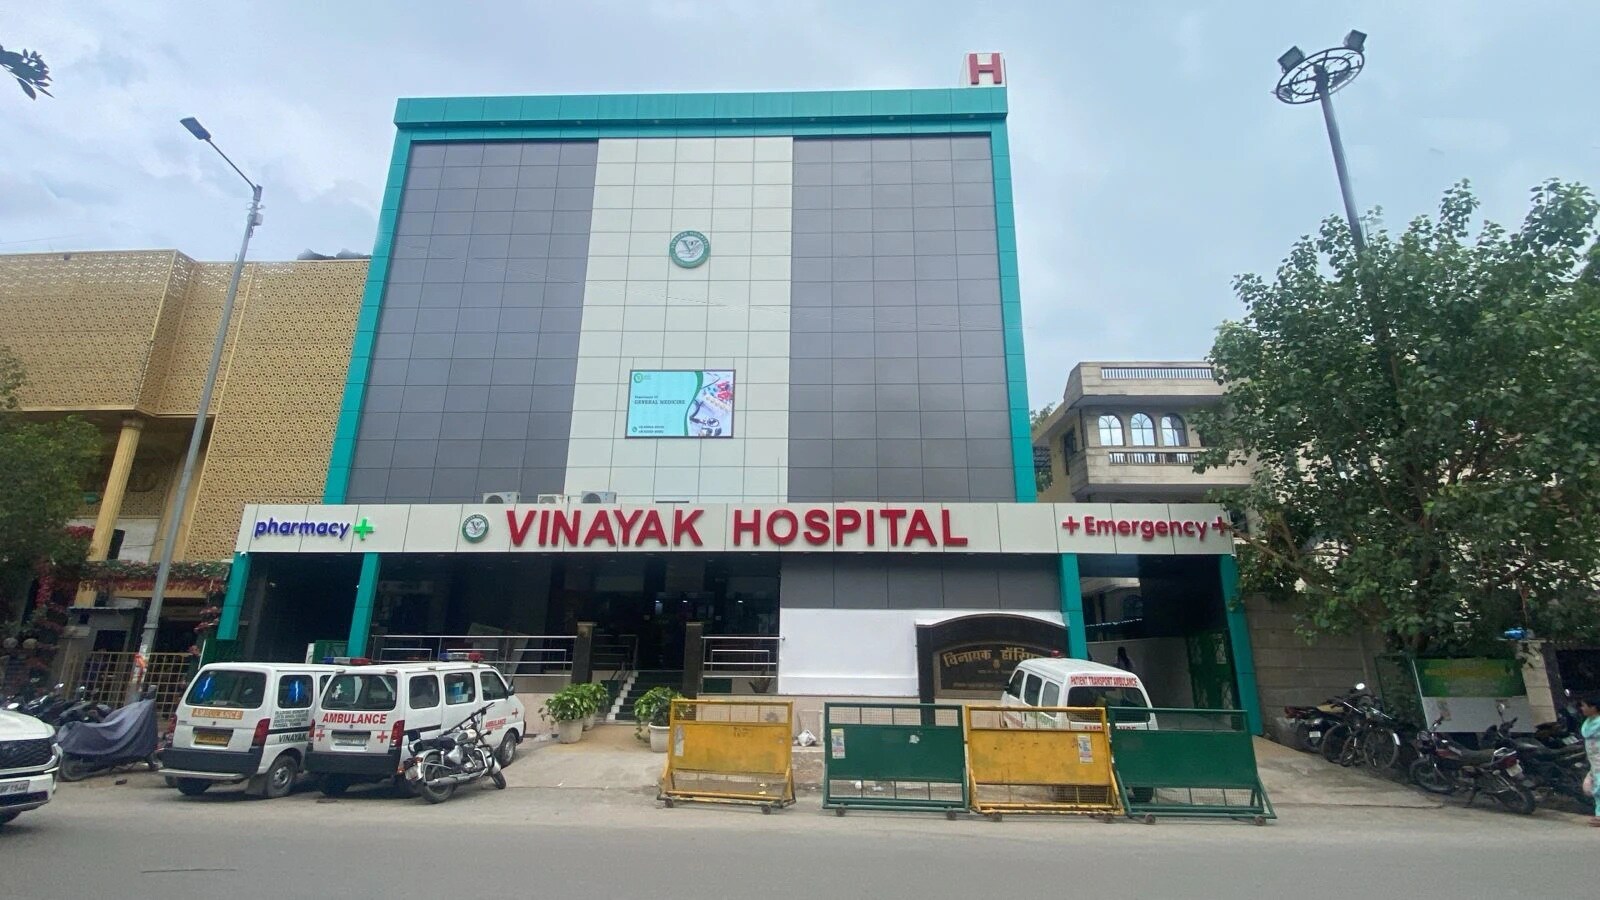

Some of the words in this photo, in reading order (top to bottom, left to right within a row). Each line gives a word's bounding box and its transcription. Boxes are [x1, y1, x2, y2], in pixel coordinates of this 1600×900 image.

[969, 53, 1002, 85] H
[254, 517, 350, 540] pharmacy
[507, 509, 706, 547] VINAYAK
[733, 508, 969, 547] HOSPITAL
[1084, 516, 1207, 541] Emergency
[1070, 676, 1087, 686] PATIENT
[1088, 676, 1113, 686] TRANSPORT
[1113, 676, 1138, 687] AMBULANCE
[194, 708, 241, 719] AMBULANCE
[322, 713, 388, 724] AMBULANCE
